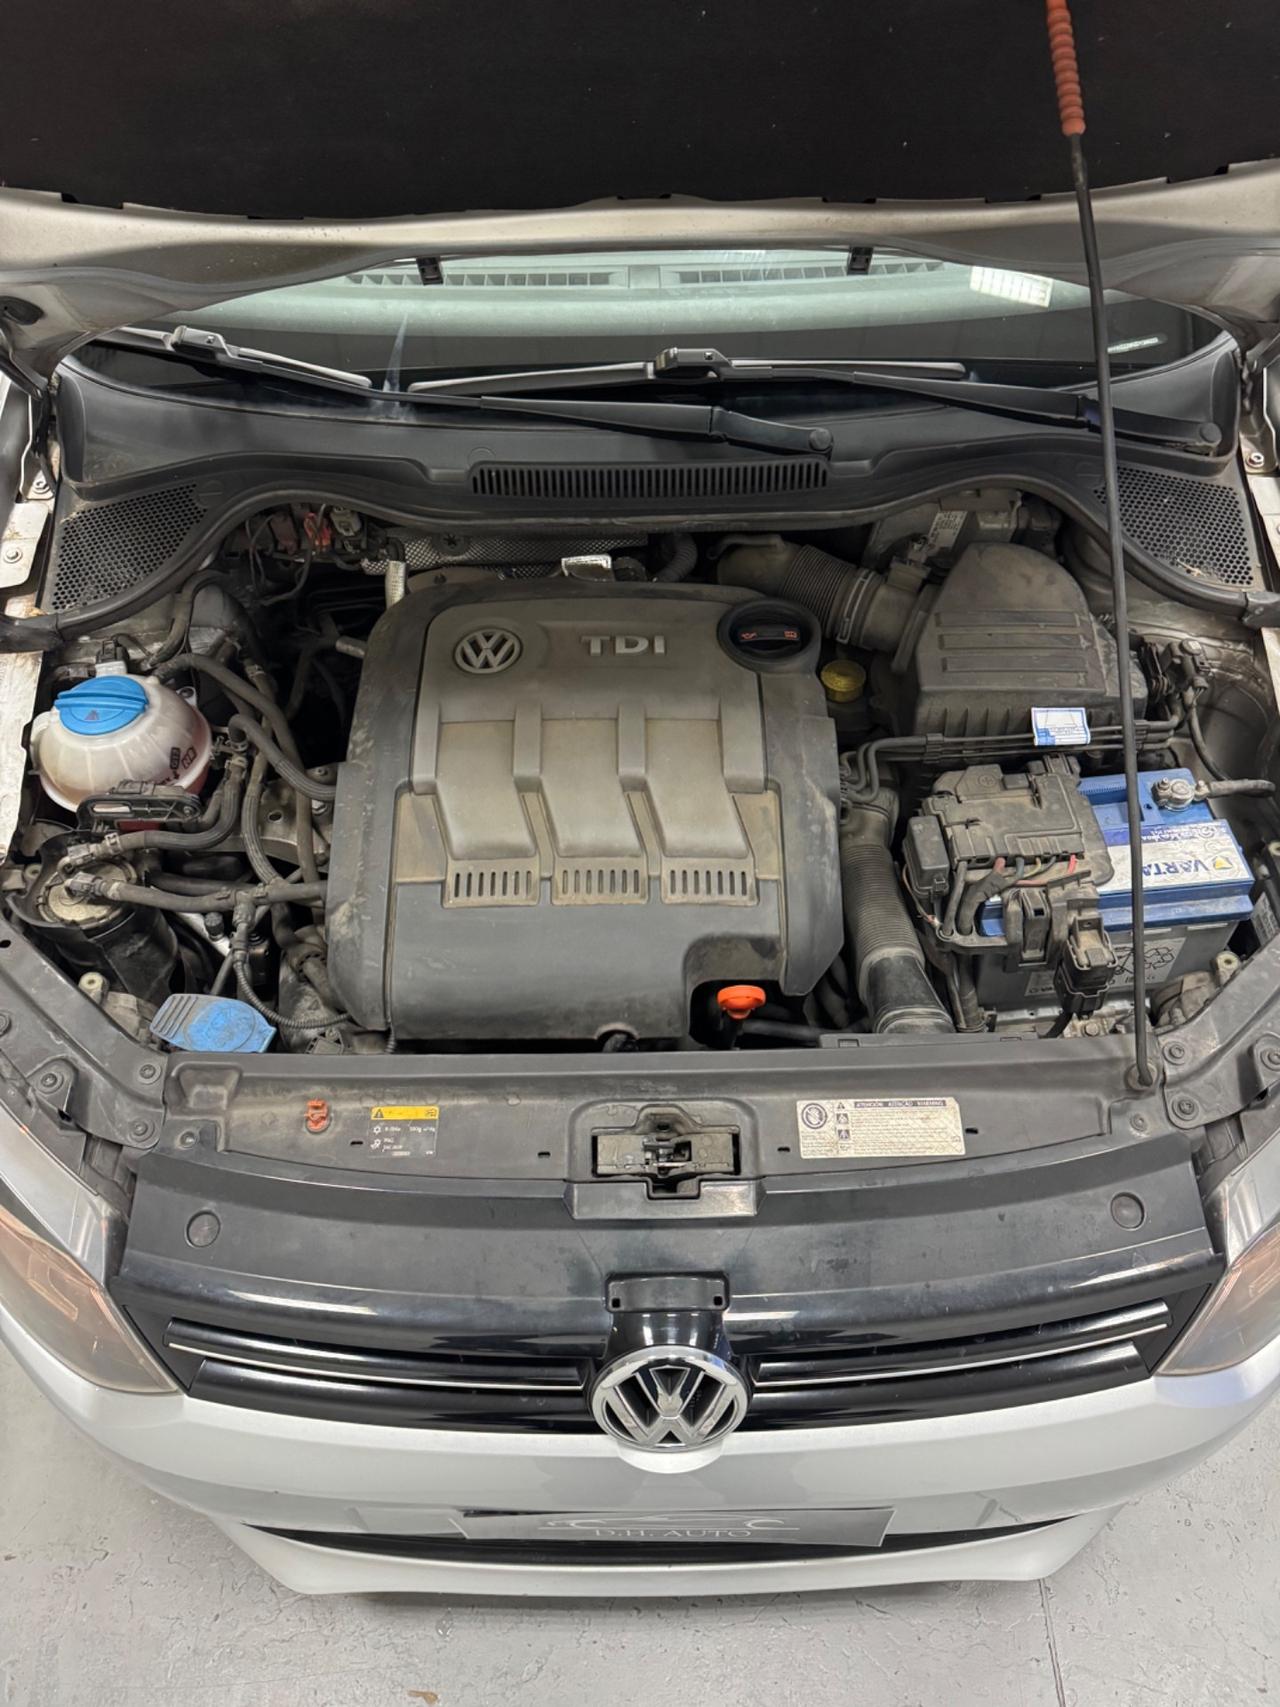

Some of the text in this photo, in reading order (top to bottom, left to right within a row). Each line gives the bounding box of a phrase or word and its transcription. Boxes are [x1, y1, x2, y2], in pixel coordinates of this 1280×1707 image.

[581, 635, 665, 656] TDI
[1142, 859, 1209, 876] VARTA
[595, 1529, 751, 1538] D.H. AUTO
